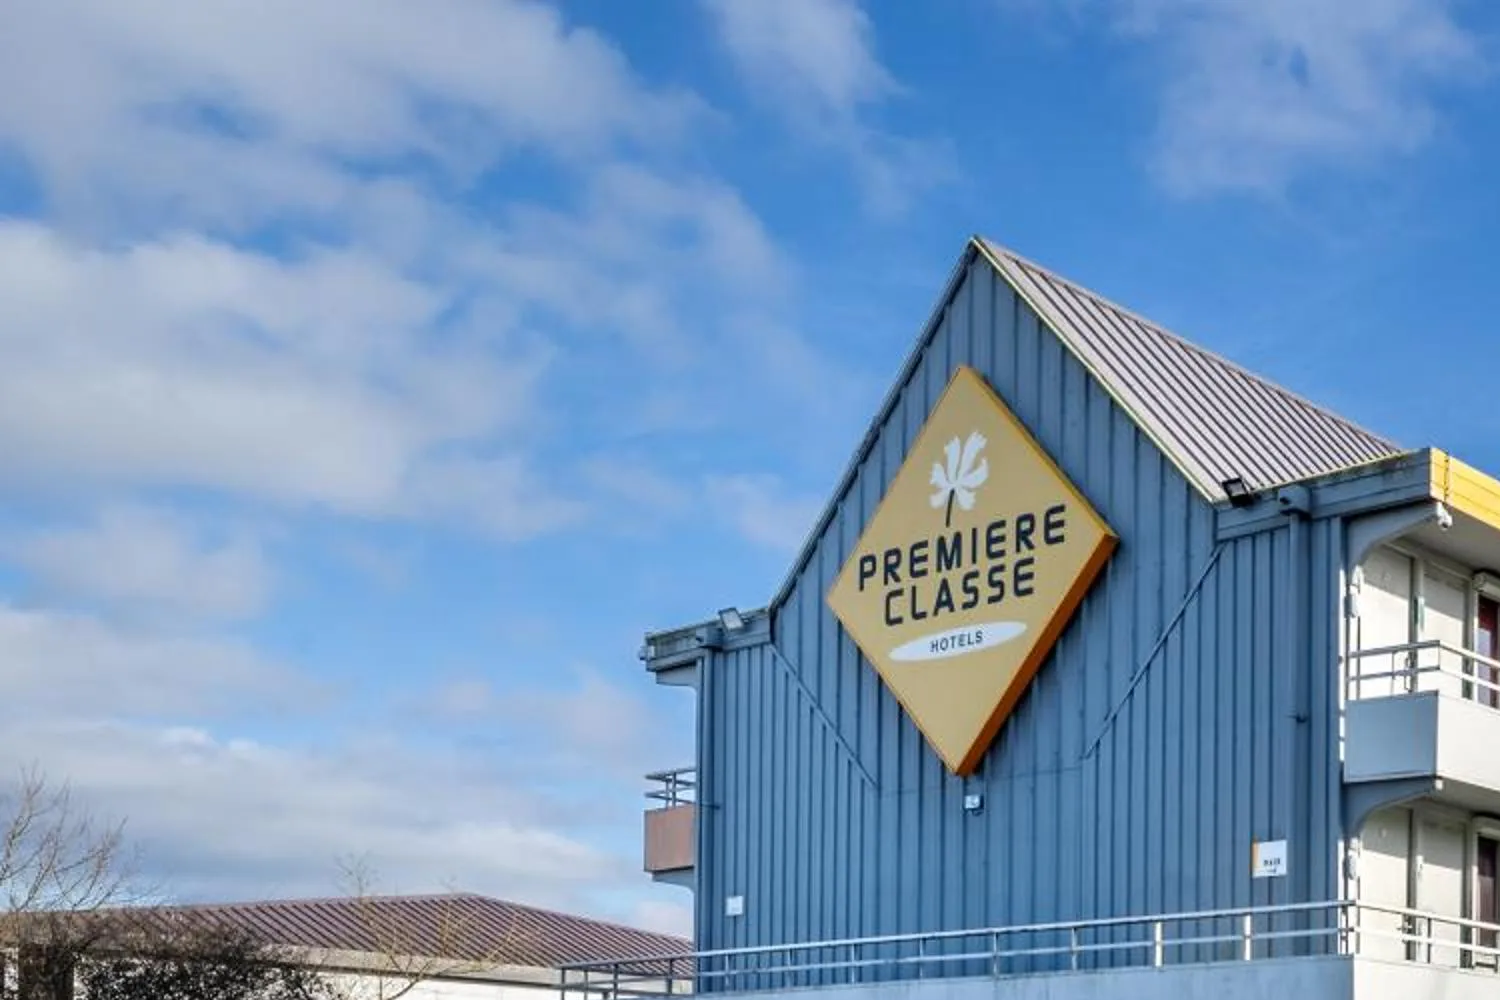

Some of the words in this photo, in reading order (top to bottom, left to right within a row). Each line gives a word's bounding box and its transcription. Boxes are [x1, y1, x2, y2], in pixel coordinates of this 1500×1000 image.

[859, 504, 1066, 592] PREMIERE
[885, 556, 1035, 626] CLASSE
[930, 630, 983, 652] HOTELS
